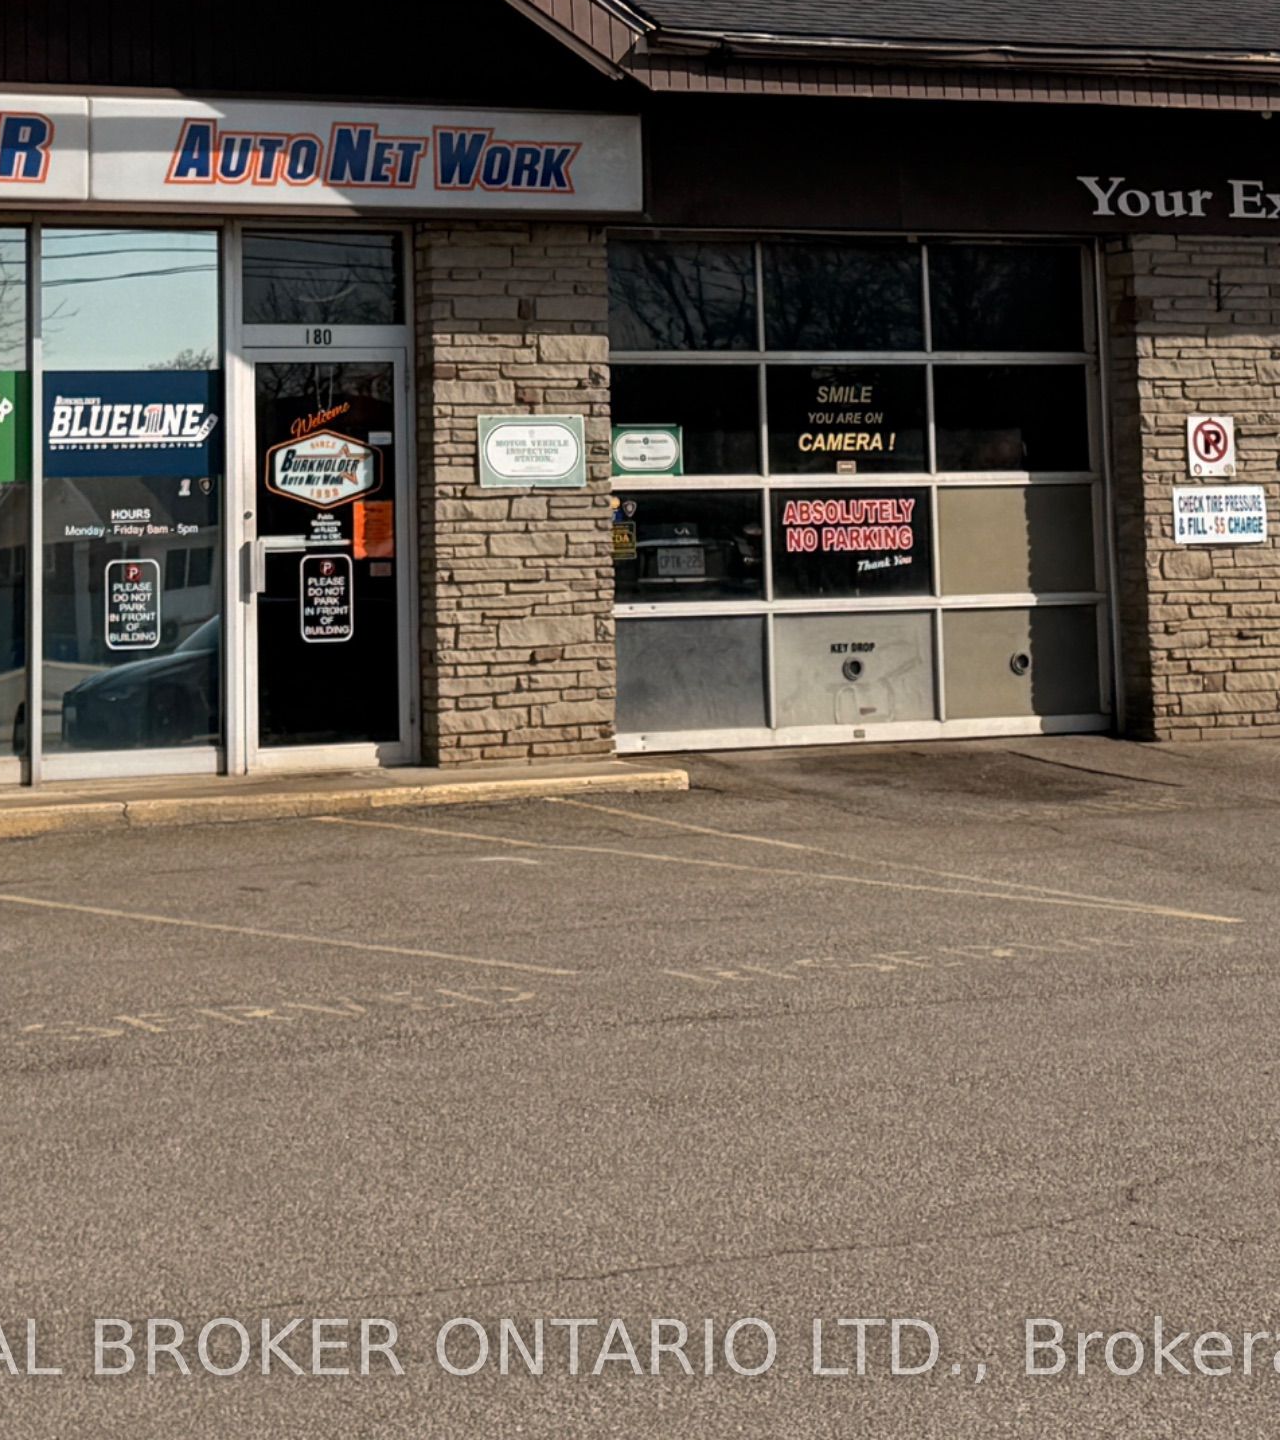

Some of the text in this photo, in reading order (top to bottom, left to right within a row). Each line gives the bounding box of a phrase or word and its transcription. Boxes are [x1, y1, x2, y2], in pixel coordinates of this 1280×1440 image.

[164, 118, 582, 194] AUTO NET WORK
[1077, 176, 1212, 217] Your
[305, 328, 332, 345] 180
[816, 385, 873, 403] SMILE
[808, 412, 884, 424] YOU ARE ON
[798, 432, 883, 451] CAMERA
[280, 448, 360, 473] BURKHOLDER
[1178, 494, 1262, 513] CHECK TIRE PRESSURE
[111, 509, 151, 520] HOURS
[783, 498, 915, 525] ABSOLUTELY
[65, 525, 104, 536] Monday
[114, 524, 144, 536] Friday
[177, 523, 198, 534] 5pm
[1188, 517, 1207, 535] FILL
[1228, 516, 1263, 534] CHARGE
[786, 525, 913, 552] NO PARKING
[857, 557, 891, 572] Thank
[308, 576, 345, 586] PLEASE
[113, 582, 152, 592] PLEASE
[308, 586, 345, 596] DO NOT
[113, 592, 152, 602] DO NOT
[314, 597, 340, 605] PARK
[119, 603, 146, 611] PARK
[304, 606, 348, 616] IN FRONT
[109, 612, 155, 622] IN FRONT
[320, 616, 334, 625] OF
[126, 623, 140, 631] OF
[305, 625, 349, 635] BUILDING
[109, 632, 156, 642] BUILDING
[831, 643, 848, 653] KEY
